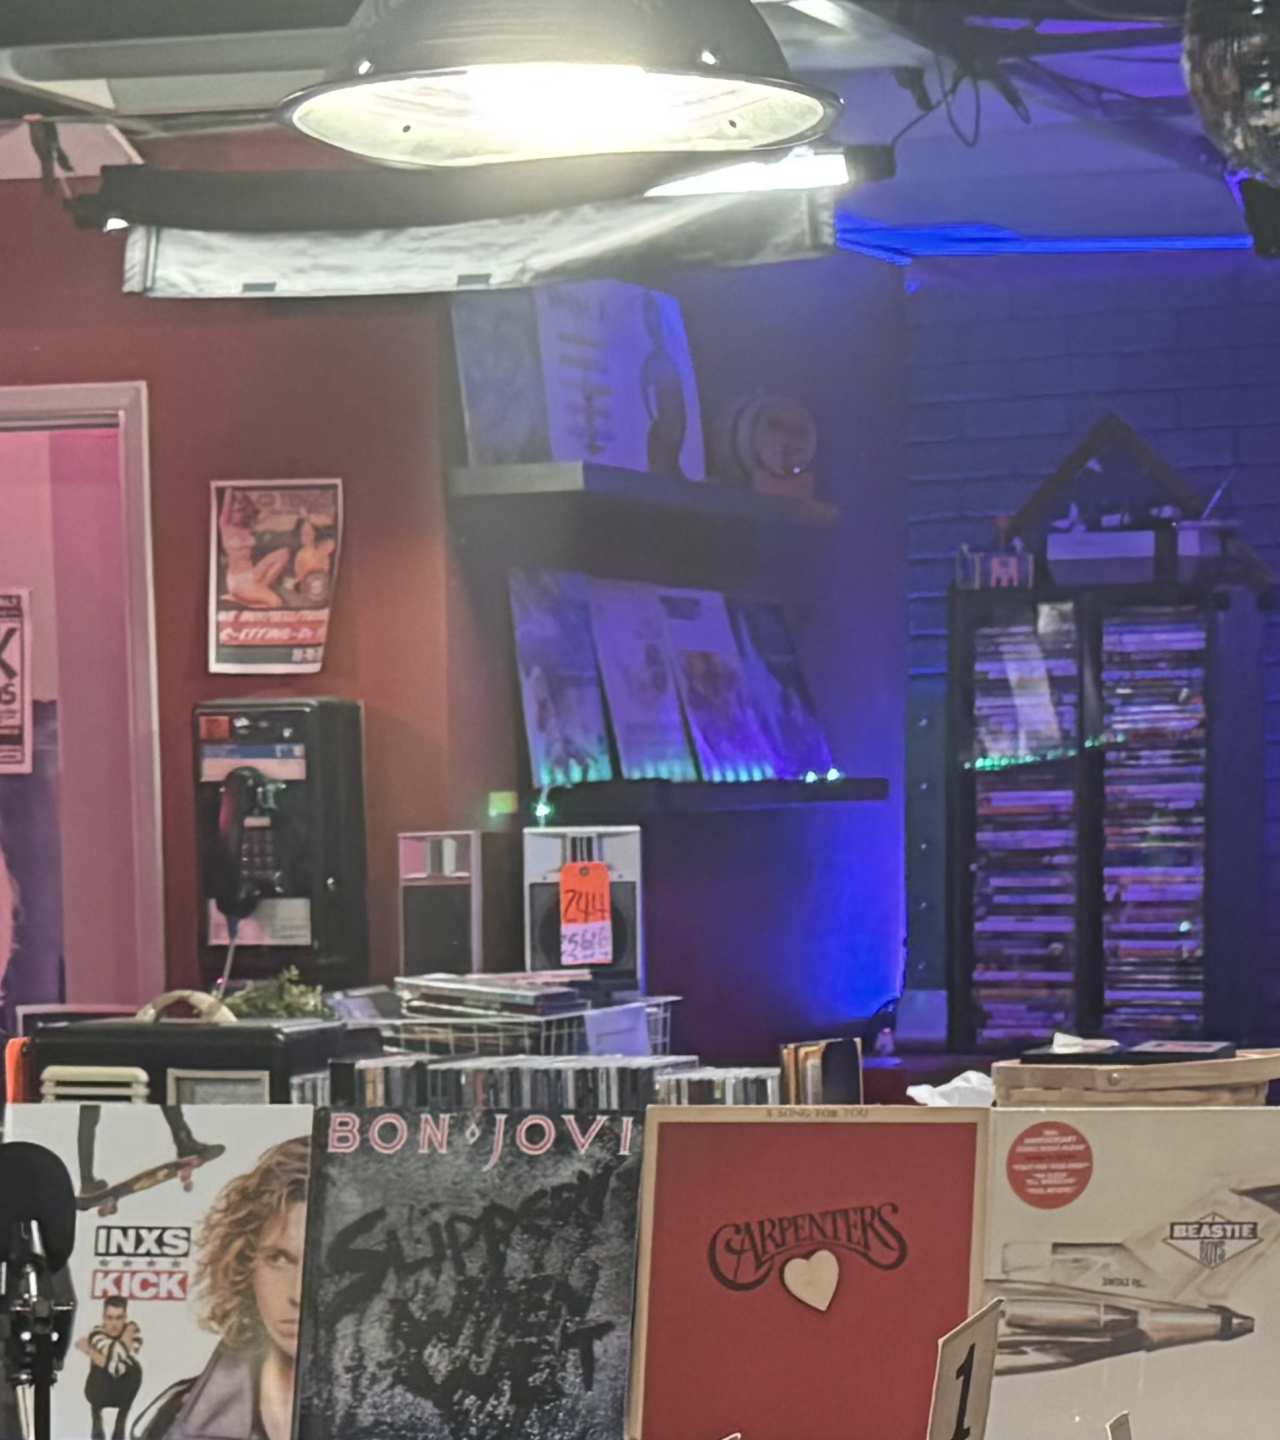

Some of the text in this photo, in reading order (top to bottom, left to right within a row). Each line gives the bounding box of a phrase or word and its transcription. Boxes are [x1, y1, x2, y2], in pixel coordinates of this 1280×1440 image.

[328, 1113, 632, 1171] BON JOVI
[98, 1228, 190, 1256] INXS
[1173, 1224, 1253, 1239] BEASTIE
[93, 1272, 187, 1299] KICK
